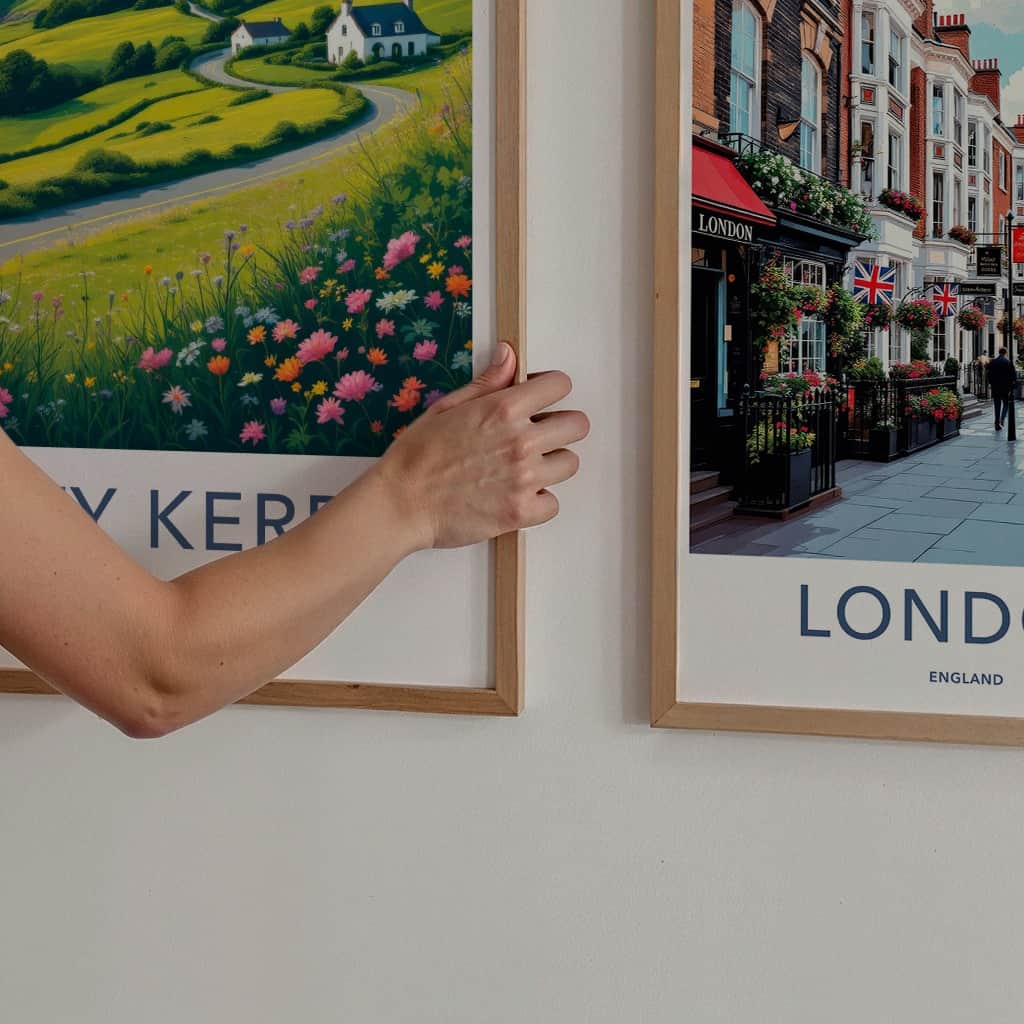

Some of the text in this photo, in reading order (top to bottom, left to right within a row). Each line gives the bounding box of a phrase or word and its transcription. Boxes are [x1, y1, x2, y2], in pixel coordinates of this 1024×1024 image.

[698, 213, 753, 242] LONDON
[800, 584, 1024, 645] LOND
[929, 671, 1004, 686] ENGLAND
